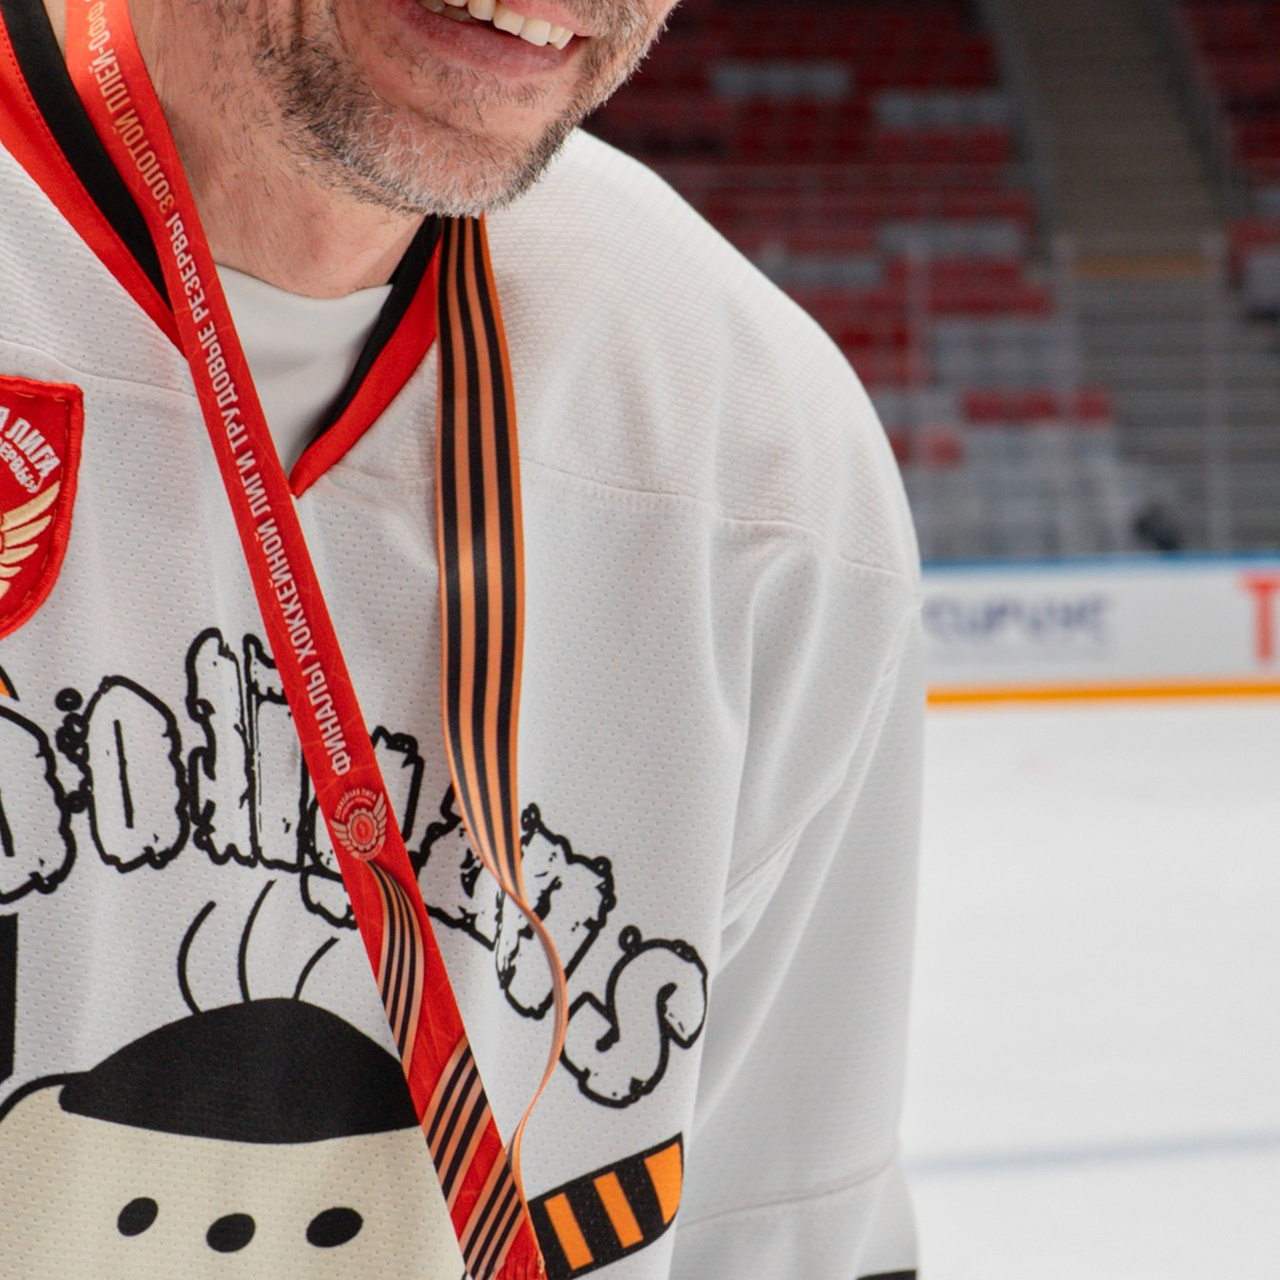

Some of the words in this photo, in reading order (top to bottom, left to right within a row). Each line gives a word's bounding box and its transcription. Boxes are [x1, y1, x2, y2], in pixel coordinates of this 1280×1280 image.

[87, 1, 131, 114] ПЛЕЙ-ОФФ
[111, 108, 175, 214] ЗОЛОТОЙ
[165, 212, 210, 324] РЕЗЕРВЫ
[197, 320, 249, 454] ТРУДОВЫЕ
[5, 417, 61, 478] ЛИГА
[235, 450, 272, 518] ЛИГИ
[253, 517, 318, 663] ХОККЕЙНОЙ
[301, 661, 352, 776] ФИНАЛЫ
